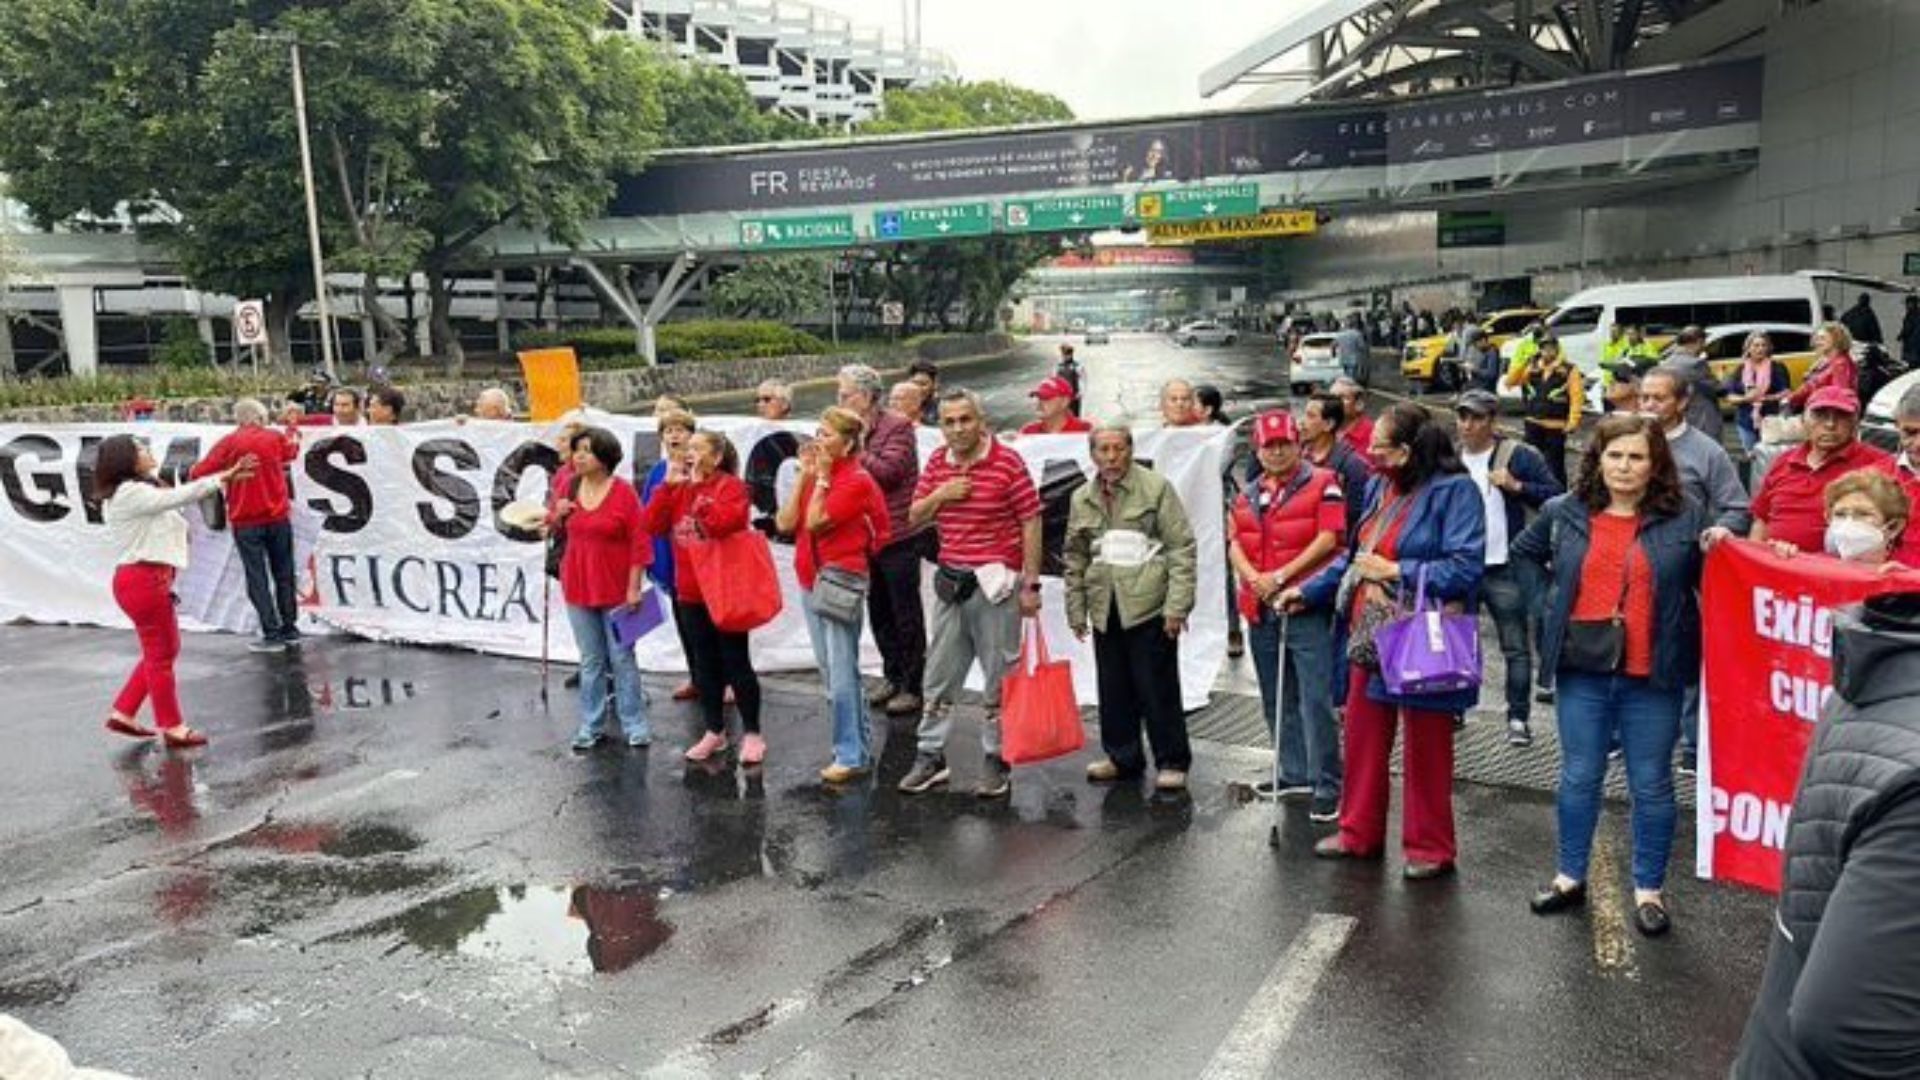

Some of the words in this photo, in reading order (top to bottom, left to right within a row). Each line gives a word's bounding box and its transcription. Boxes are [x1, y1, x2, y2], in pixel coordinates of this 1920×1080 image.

[750, 170, 788, 195] FR
[799, 166, 851, 181] FIESTA
[905, 206, 965, 222] TERMINAL
[786, 221, 851, 239] NACIONAL
[329, 554, 542, 624] FICREA
[1753, 586, 1833, 658] Exig
